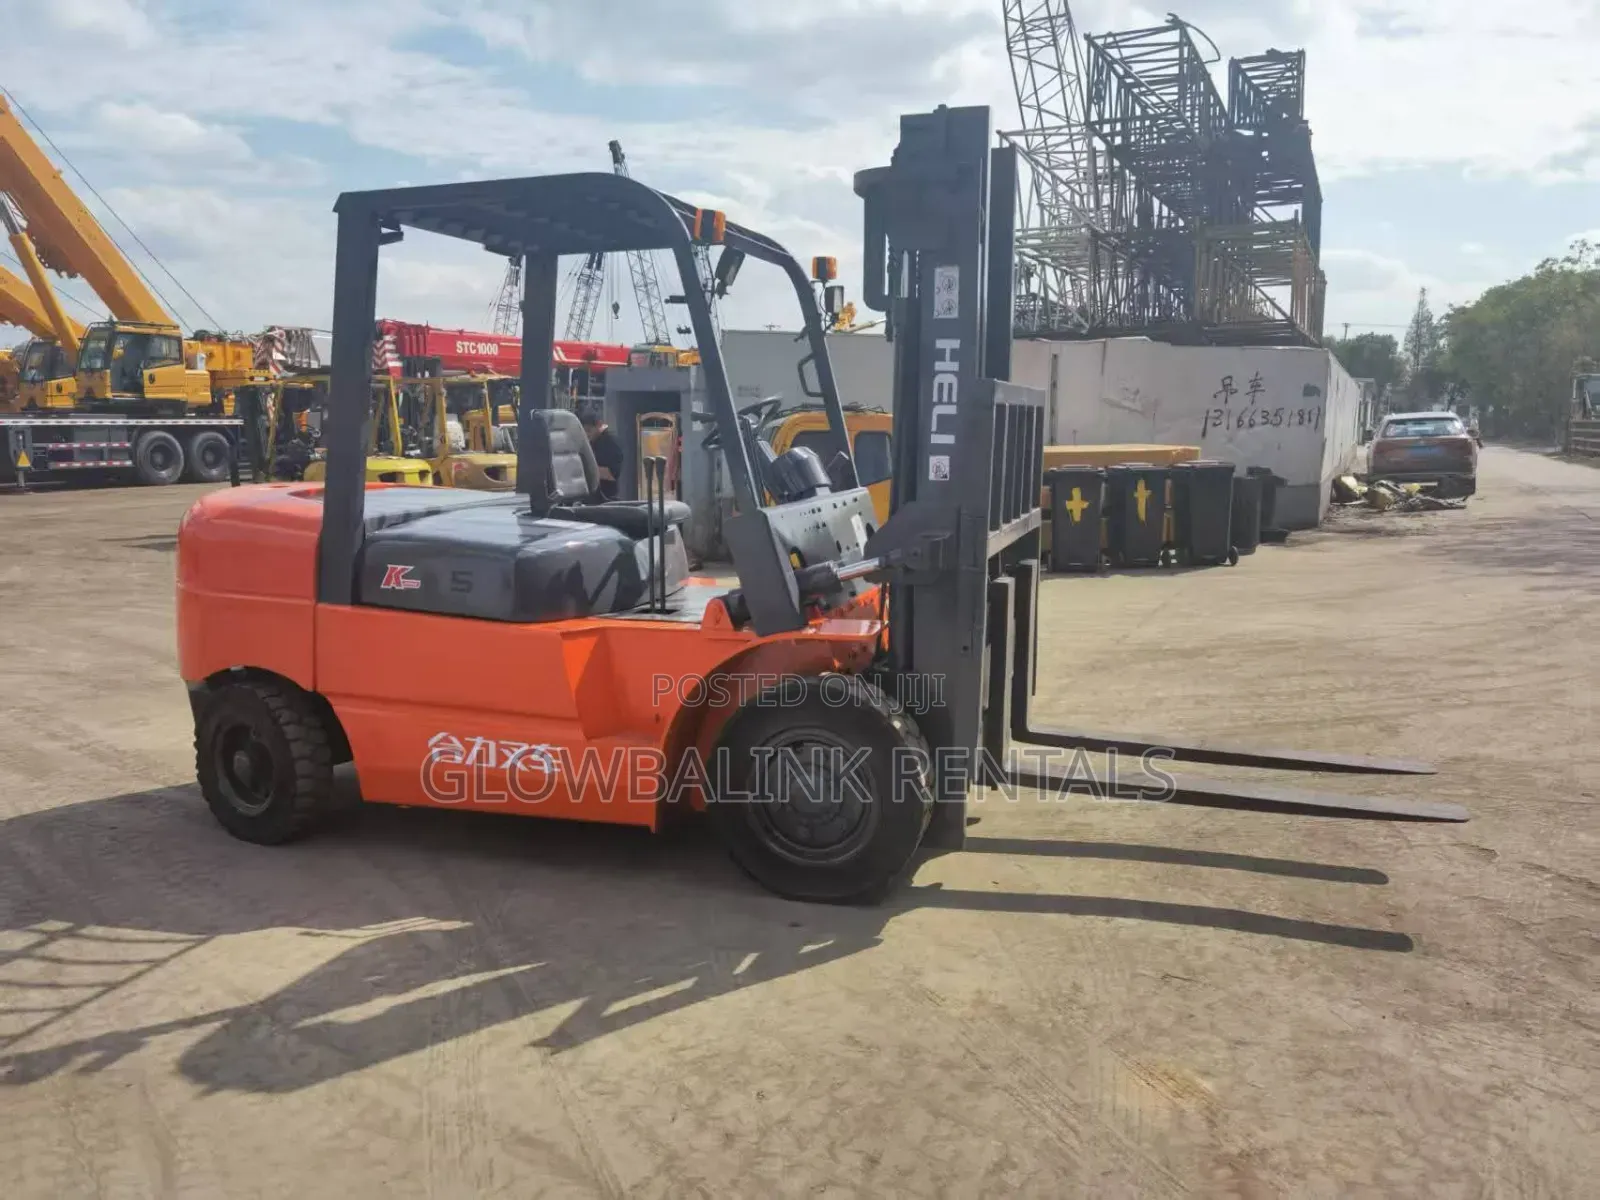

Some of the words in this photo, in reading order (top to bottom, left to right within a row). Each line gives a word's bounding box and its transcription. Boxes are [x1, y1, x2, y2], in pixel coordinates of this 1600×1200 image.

[456, 341, 499, 355] STC1000
[930, 338, 961, 444] HELI
[428, 731, 562, 774] 合力叉车
